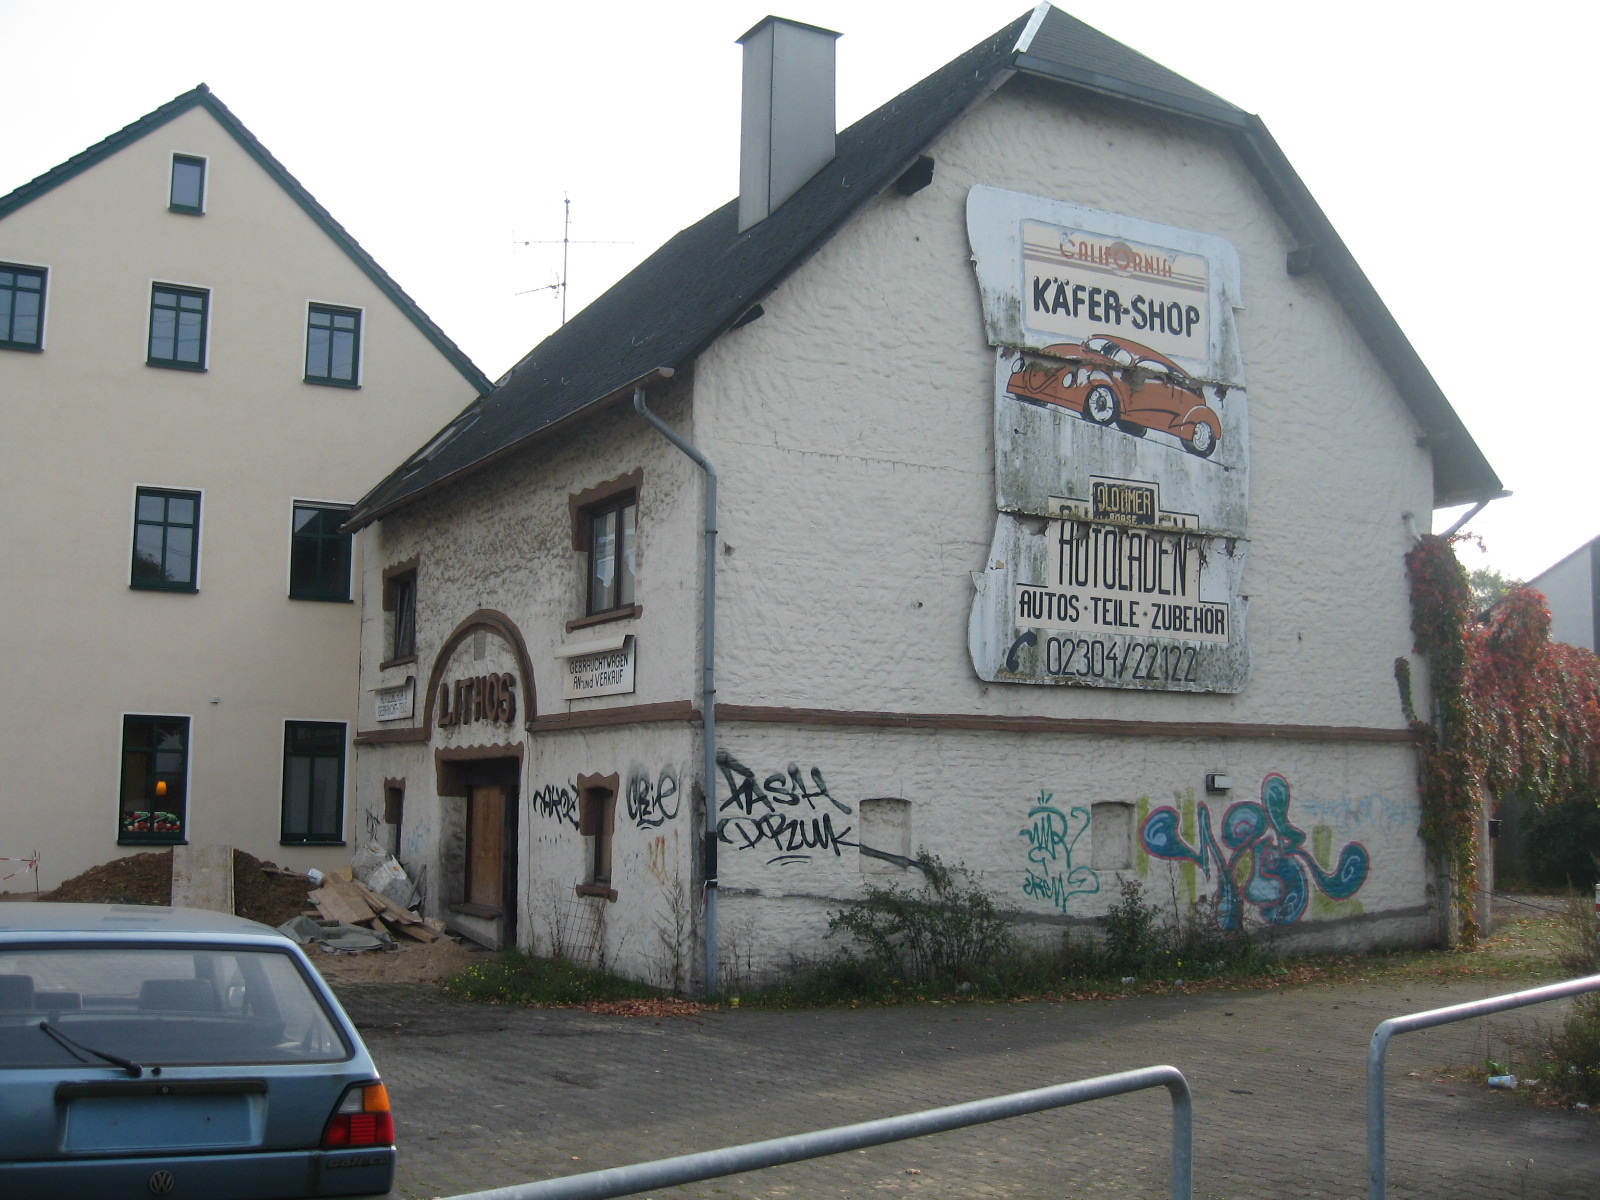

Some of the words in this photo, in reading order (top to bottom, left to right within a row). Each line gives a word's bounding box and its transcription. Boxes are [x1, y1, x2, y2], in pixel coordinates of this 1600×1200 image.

[1059, 236, 1173, 278] CALIFORNIA
[1033, 276, 1200, 338] KÄFER-SHOP
[1058, 506, 1188, 597] AUTOLADEN
[1019, 590, 1080, 623] AUTOS
[1090, 597, 1140, 628] TEILE
[1151, 603, 1226, 636] ZUBEHÖR
[569, 652, 629, 675] GEBRAUCHTWAGEN
[595, 669, 624, 688] VERKAUF
[1046, 636, 1197, 683] 02304/22122
[437, 672, 518, 728] LITHOS
